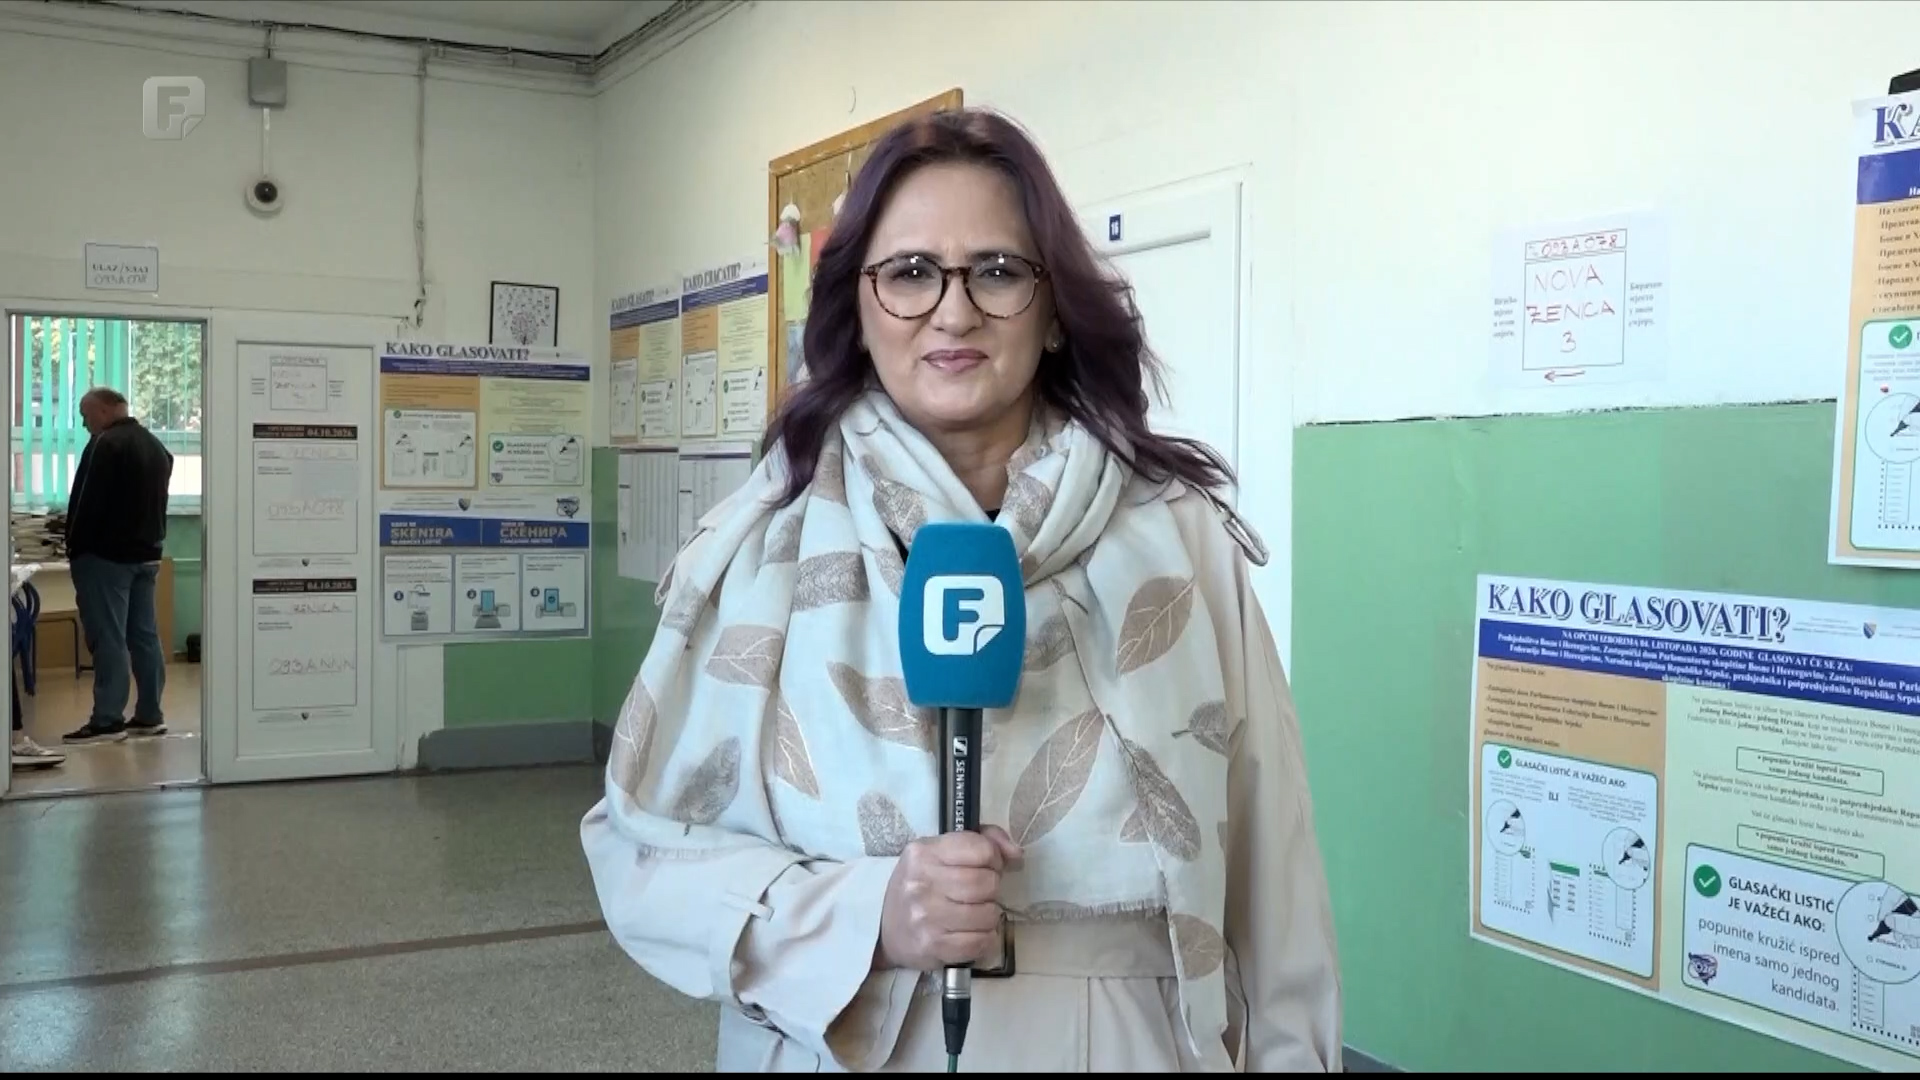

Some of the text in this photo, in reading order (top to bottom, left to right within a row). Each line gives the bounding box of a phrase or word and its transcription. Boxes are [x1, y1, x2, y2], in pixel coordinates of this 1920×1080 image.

[1533, 263, 1604, 293] NOVA
[386, 342, 530, 361] KAKO GLASOVATI?
[1560, 331, 1577, 353] 3
[390, 527, 454, 540] SKENIRA
[500, 527, 567, 539] СКЕНИРА
[1488, 583, 1574, 621] KAKO
[1579, 590, 1790, 643] GLASOVATI?
[1540, 638, 1558, 647] Bosne
[1642, 649, 1658, 659] dom
[1748, 662, 1770, 673] Bosne
[1829, 671, 1876, 687] Zastupnički
[1878, 678, 1897, 690] dom
[1562, 630, 1572, 639] NA
[1574, 632, 1599, 642] OPĆIM
[1600, 634, 1639, 648] IZBORIMA
[1652, 640, 1697, 654] LISTOPADA
[1720, 647, 1755, 660] GODINE
[1758, 651, 1807, 666] GLASOVAT
[1823, 659, 1836, 669] SE
[1541, 648, 1559, 657] Bosne
[1733, 672, 1781, 686] predsjednika
[1853, 686, 1895, 701] Republike
[955, 759, 965, 832] SENNHEISER
[1548, 791, 1559, 802] ILI
[1728, 876, 1835, 914] GLASAČKI LISTIĆ
[1728, 896, 1827, 933] JE VAŽEĆI AKO:
[1698, 917, 1840, 966] popunite kružić ispred
[1713, 941, 1840, 993] imena samo jednog
[1771, 978, 1840, 1012] kandidata.
